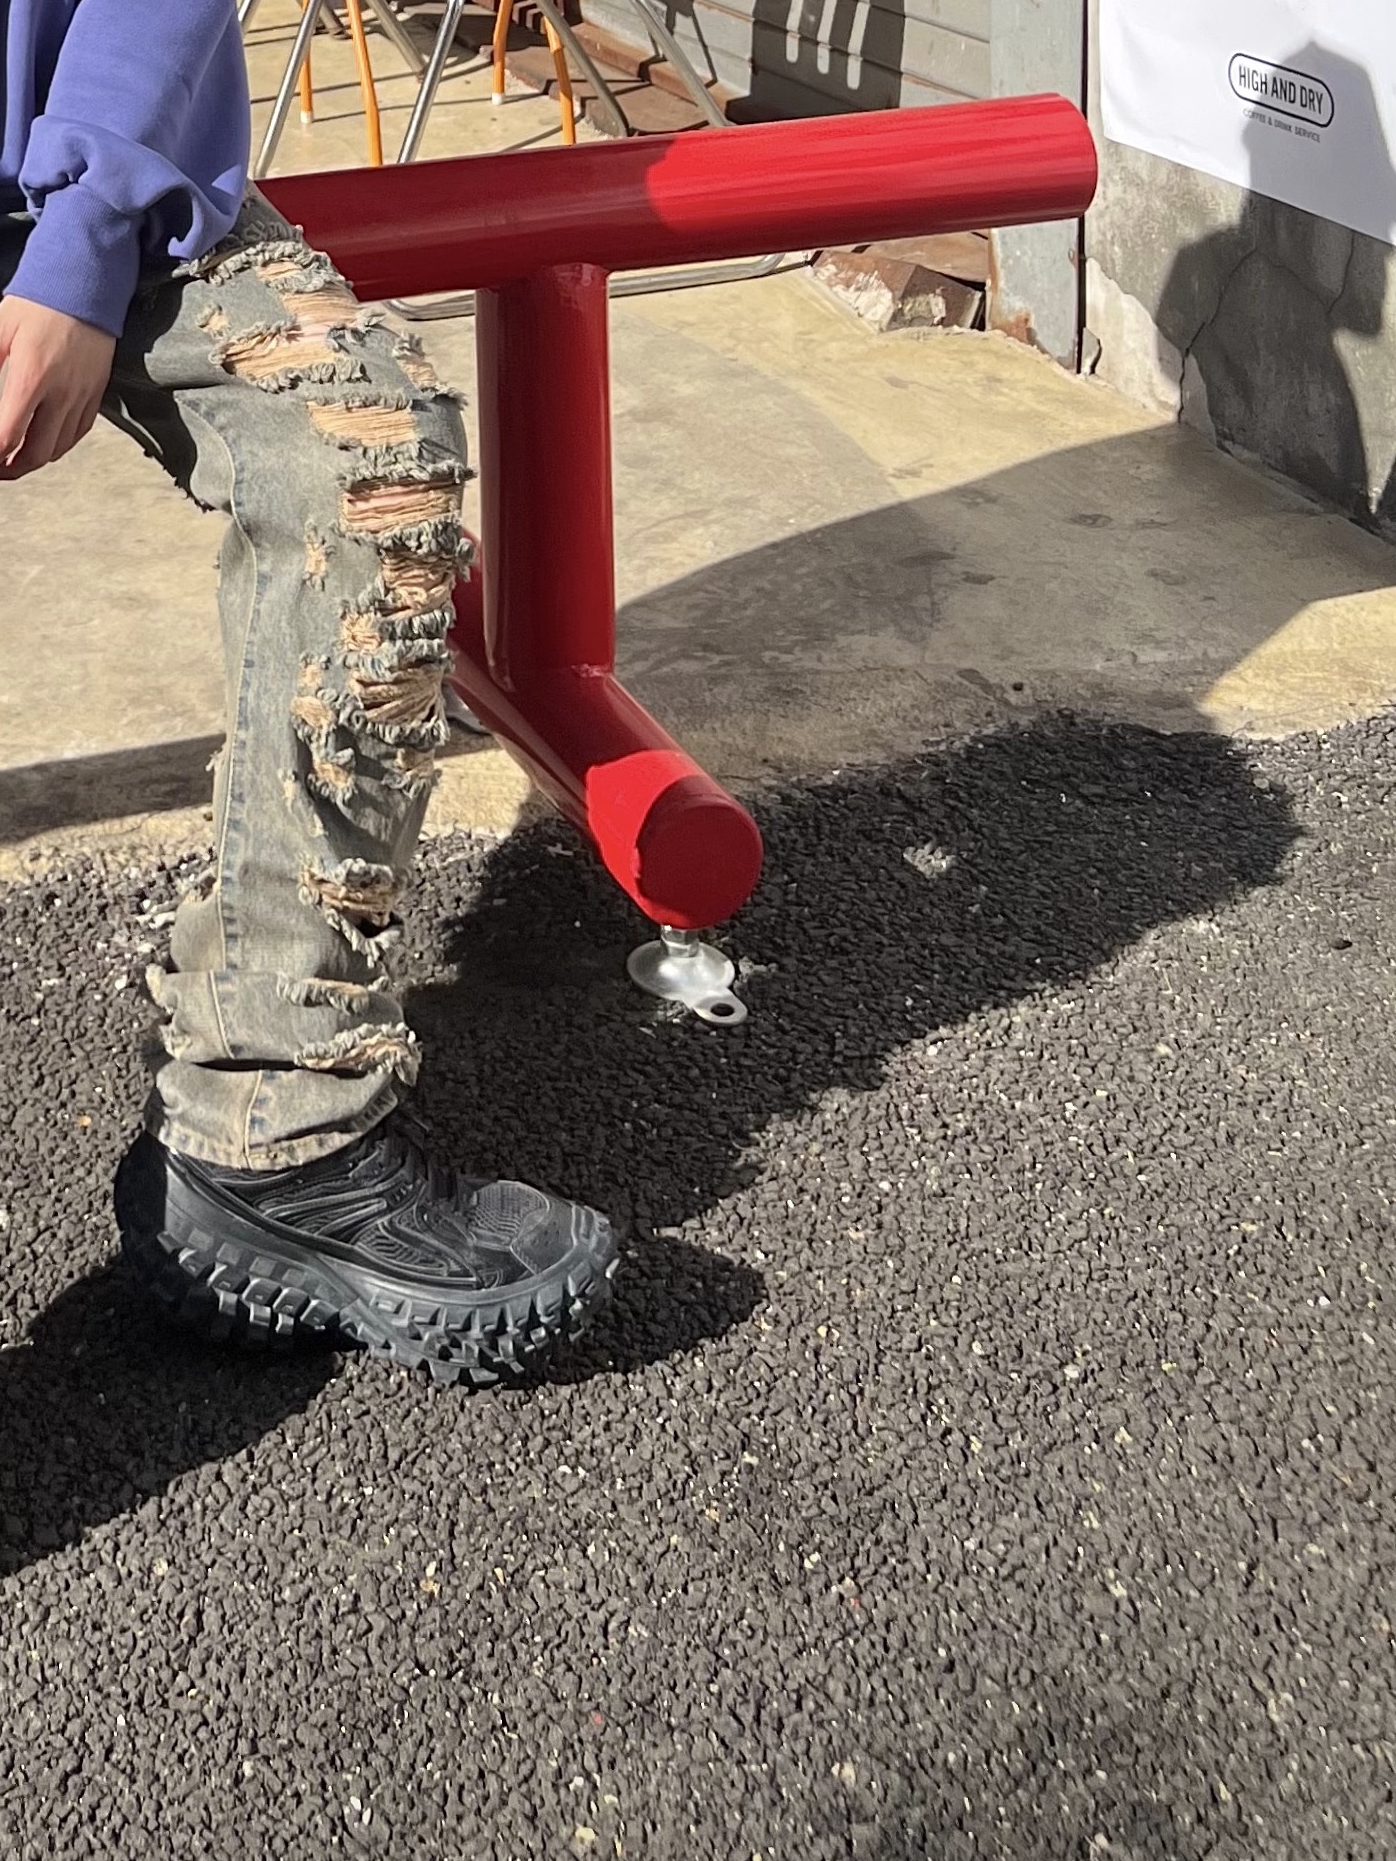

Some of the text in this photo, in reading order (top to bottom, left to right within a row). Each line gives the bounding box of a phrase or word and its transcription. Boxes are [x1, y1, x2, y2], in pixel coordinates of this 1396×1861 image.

[1238, 64, 1324, 115] HIGH AND DRY
